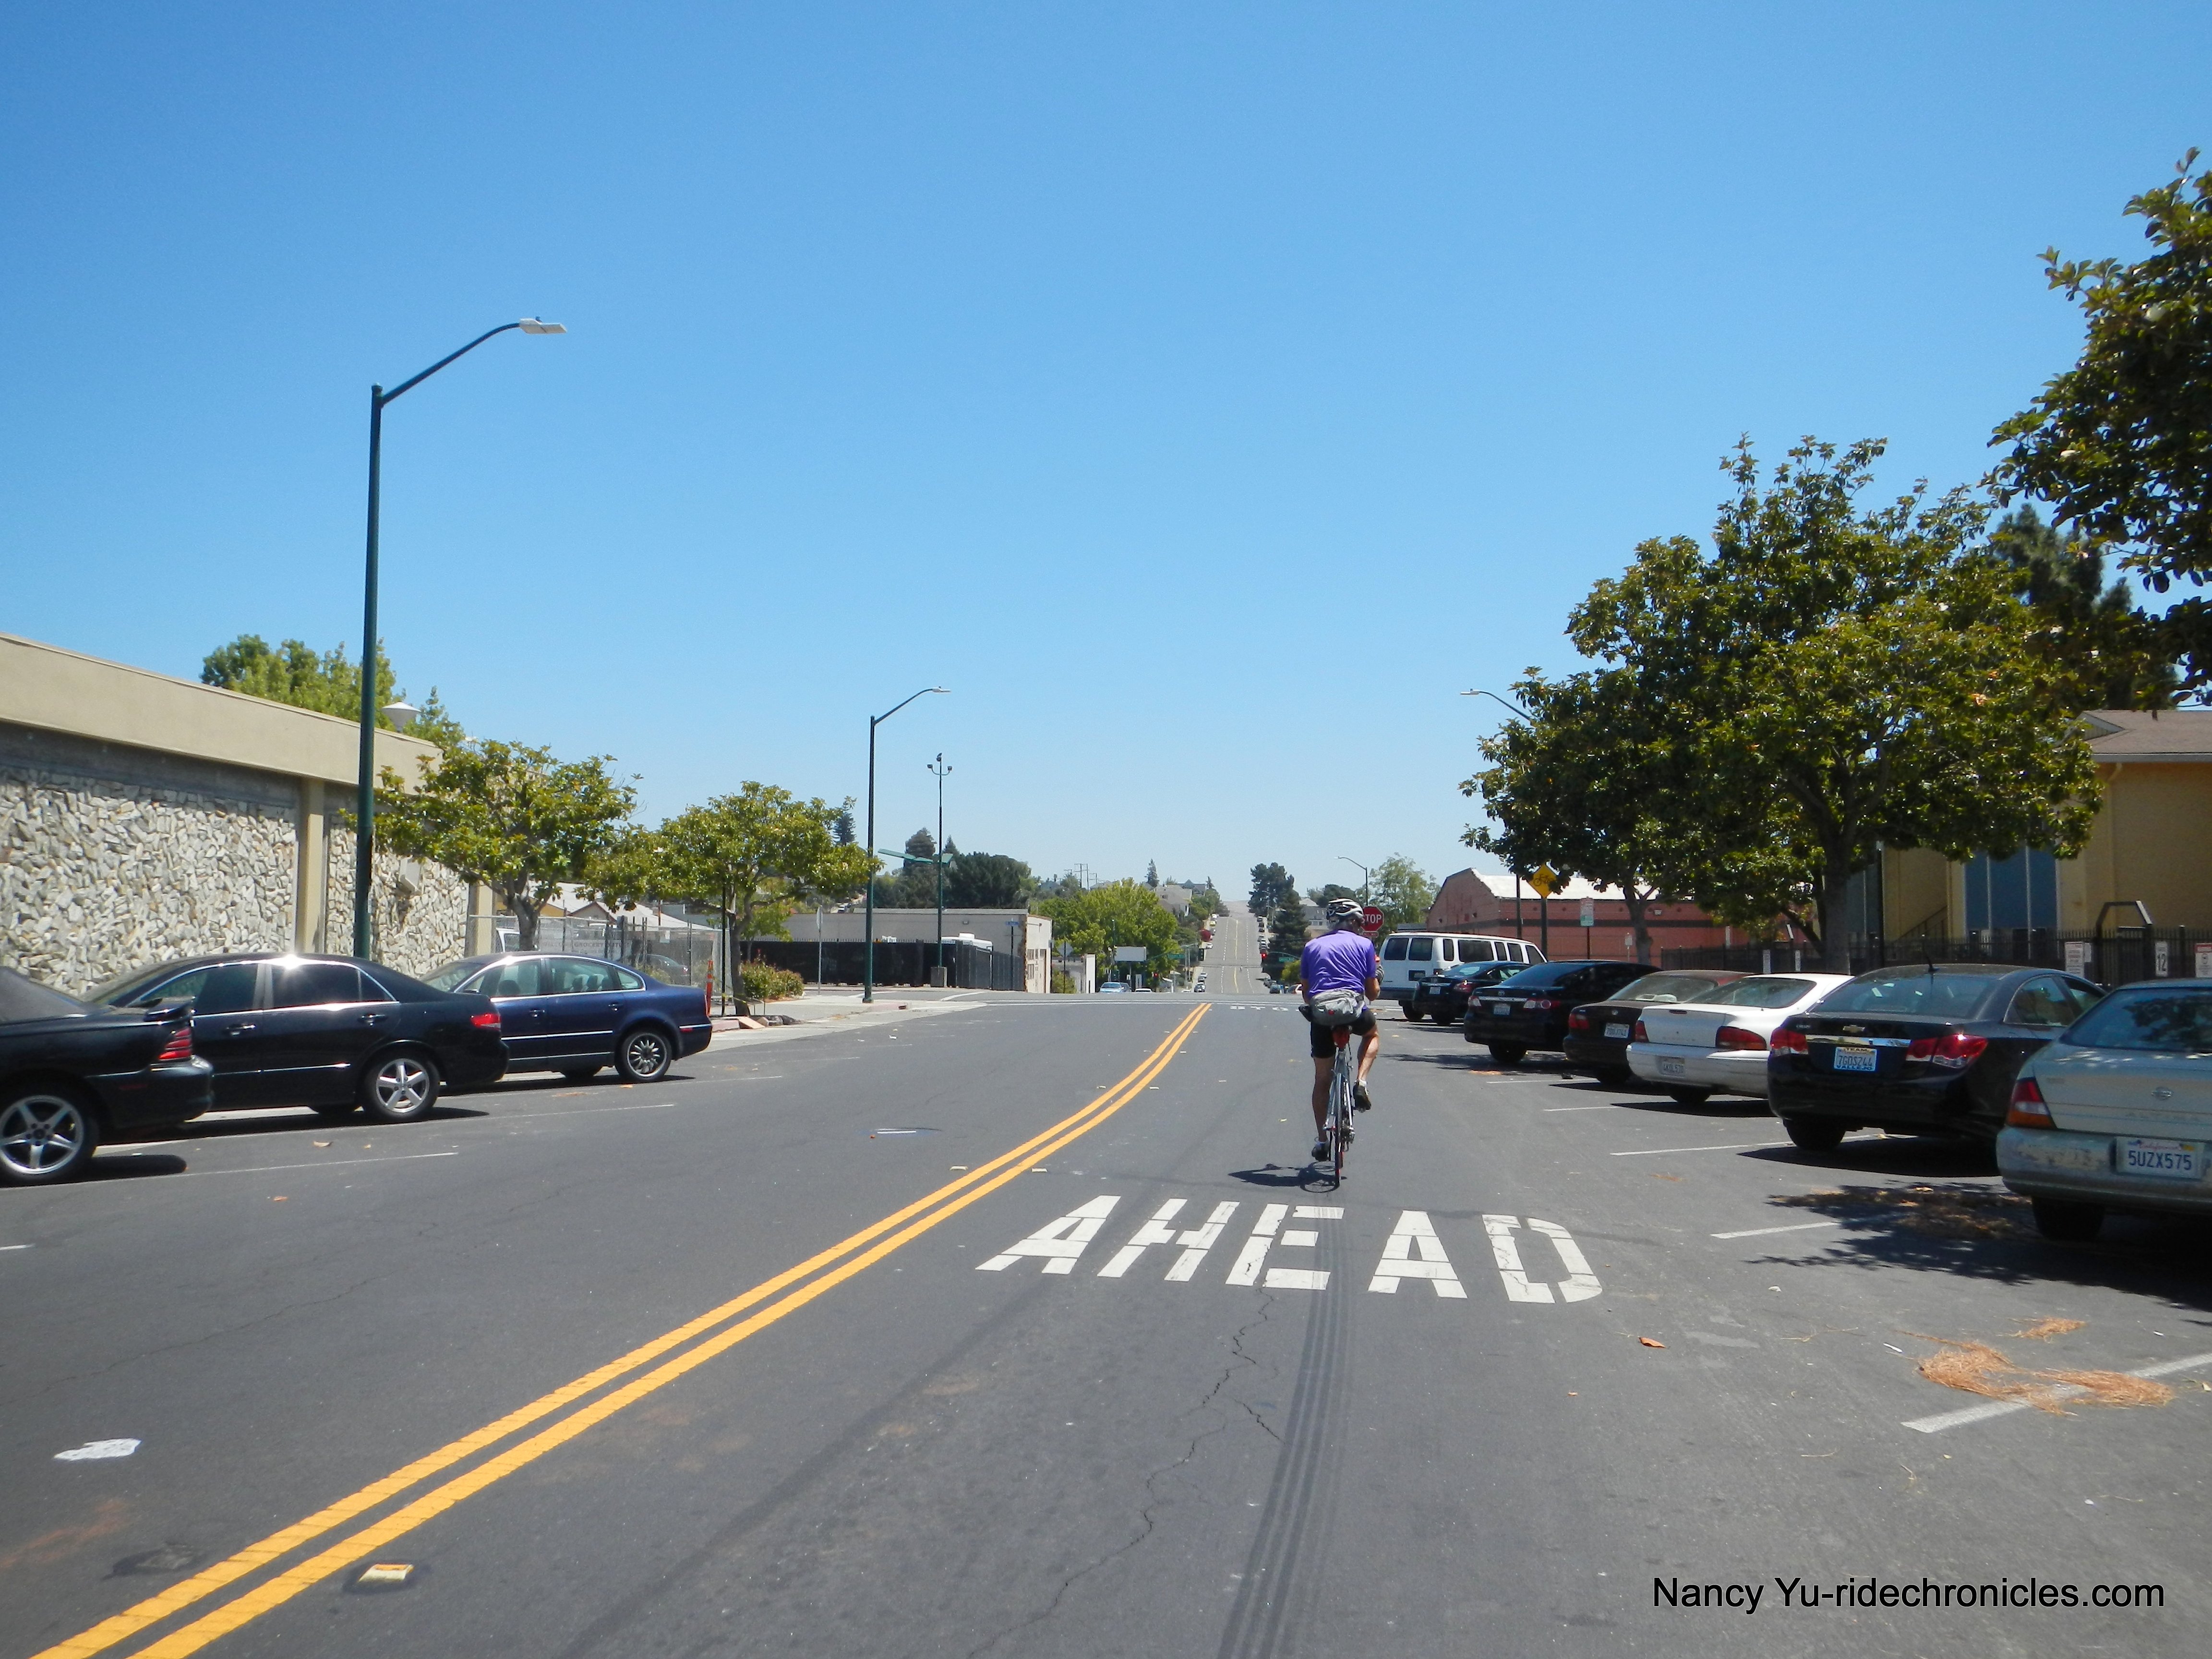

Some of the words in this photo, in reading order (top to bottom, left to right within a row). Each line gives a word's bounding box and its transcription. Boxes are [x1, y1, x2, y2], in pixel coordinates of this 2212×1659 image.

[1360, 914, 1382, 924] STOP
[2158, 953, 2166, 972] 12
[2128, 1150, 2192, 1171] 5UZX575
[975, 1194, 1602, 1304] AHEAD
